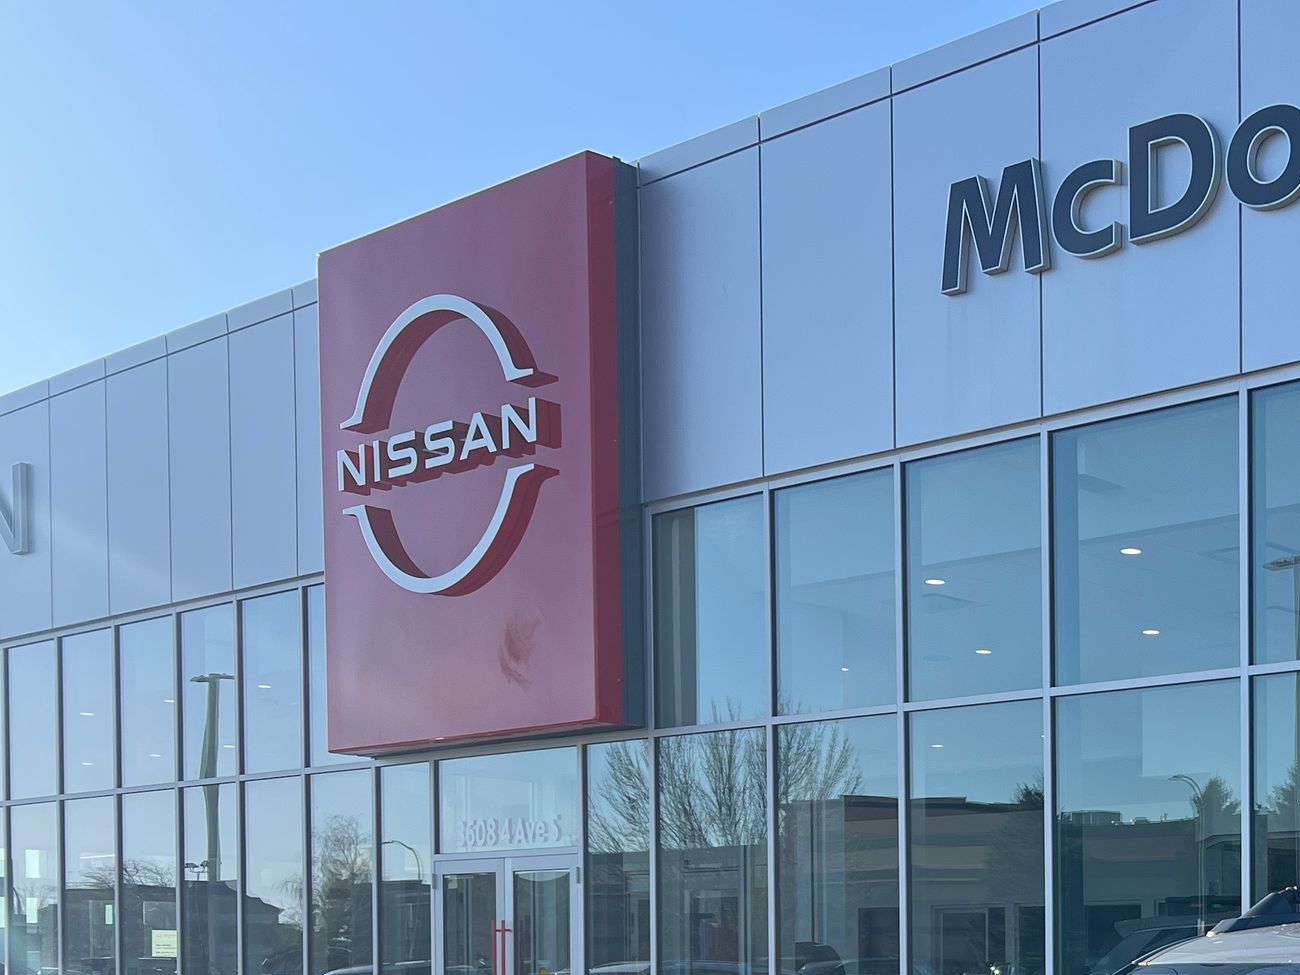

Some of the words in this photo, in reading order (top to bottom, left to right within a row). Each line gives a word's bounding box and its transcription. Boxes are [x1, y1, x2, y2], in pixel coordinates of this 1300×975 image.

[337, 396, 538, 492] NISSAN
[499, 816, 513, 843] 4
[514, 816, 548, 844] Ave
